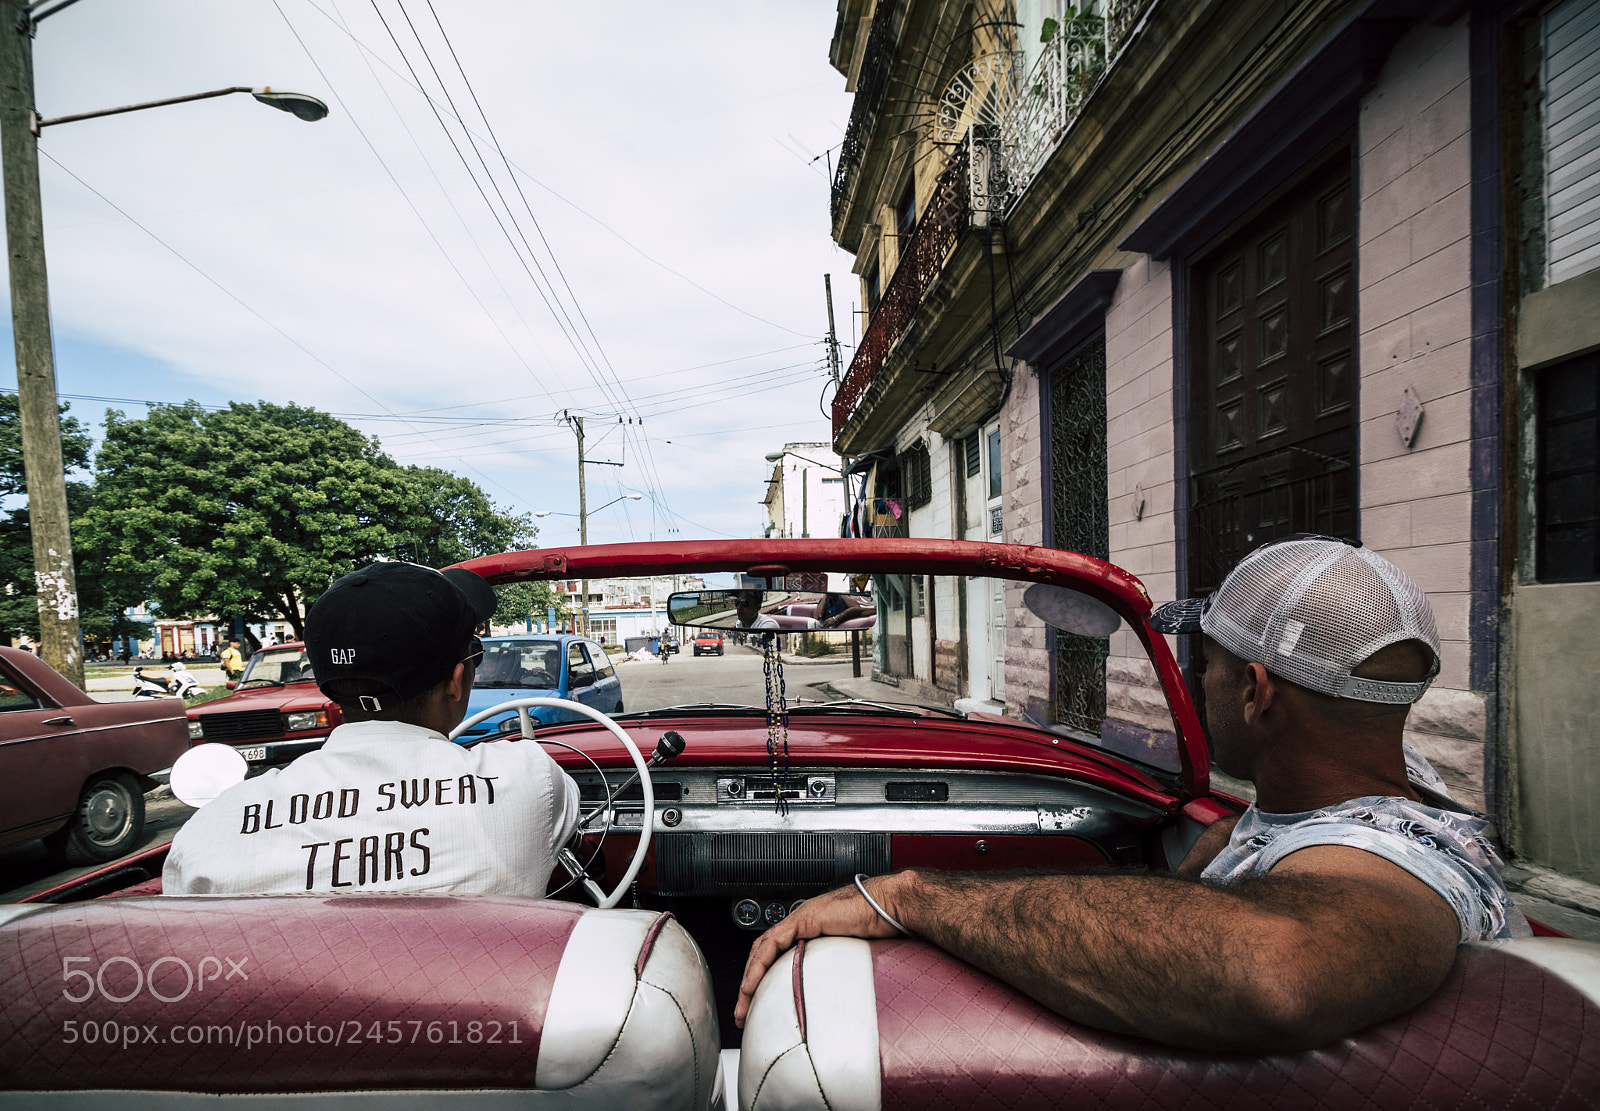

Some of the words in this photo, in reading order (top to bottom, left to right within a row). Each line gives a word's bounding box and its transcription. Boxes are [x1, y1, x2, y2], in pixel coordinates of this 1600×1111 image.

[330, 648, 356, 665] GAP
[240, 788, 360, 834] BLOOD
[376, 773, 499, 812] SWEAT
[301, 828, 430, 890] TEARS
